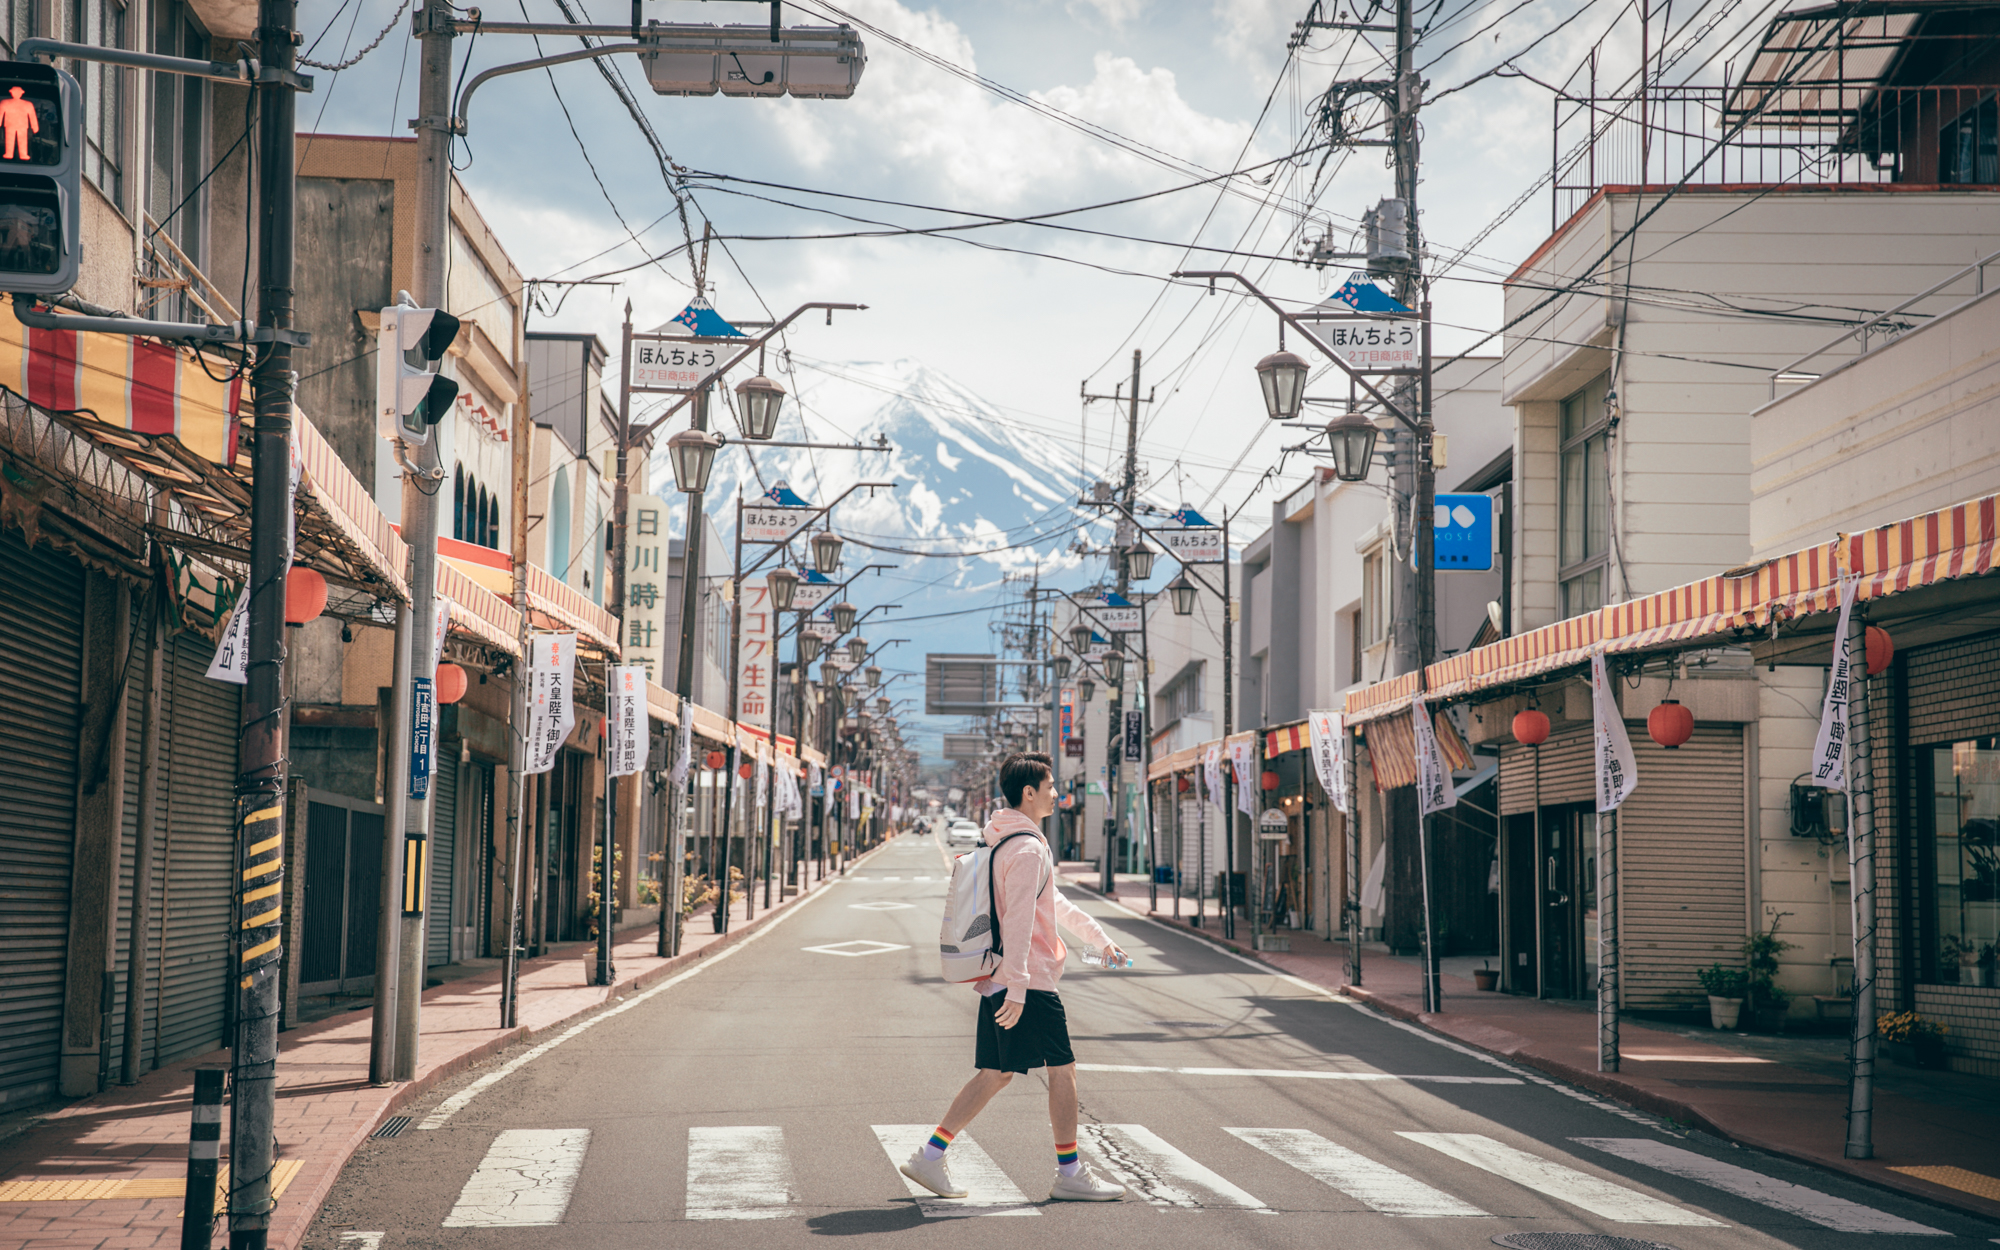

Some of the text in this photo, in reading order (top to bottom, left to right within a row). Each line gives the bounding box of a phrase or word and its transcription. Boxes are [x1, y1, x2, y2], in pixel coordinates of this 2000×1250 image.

[1332, 326, 1414, 346] ほんちょう
[639, 346, 716, 367] ほんちょう
[1348, 350, 1414, 362] 2丁目商店街
[638, 369, 699, 383] 2丁目商店街
[747, 514, 798, 528] ほんちょう
[1170, 535, 1219, 547] ほんちょう
[1434, 530, 1473, 541] KOSÉ
[1101, 610, 1139, 621] ほんちょう
[551, 642, 560, 667] 奉祝
[742, 586, 768, 716] フコク生命
[624, 672, 634, 691] 奉祝
[419, 691, 431, 755] 下吉田二丁目
[624, 695, 636, 771] 天皇陛下御即位
[419, 758, 425, 770] 1
